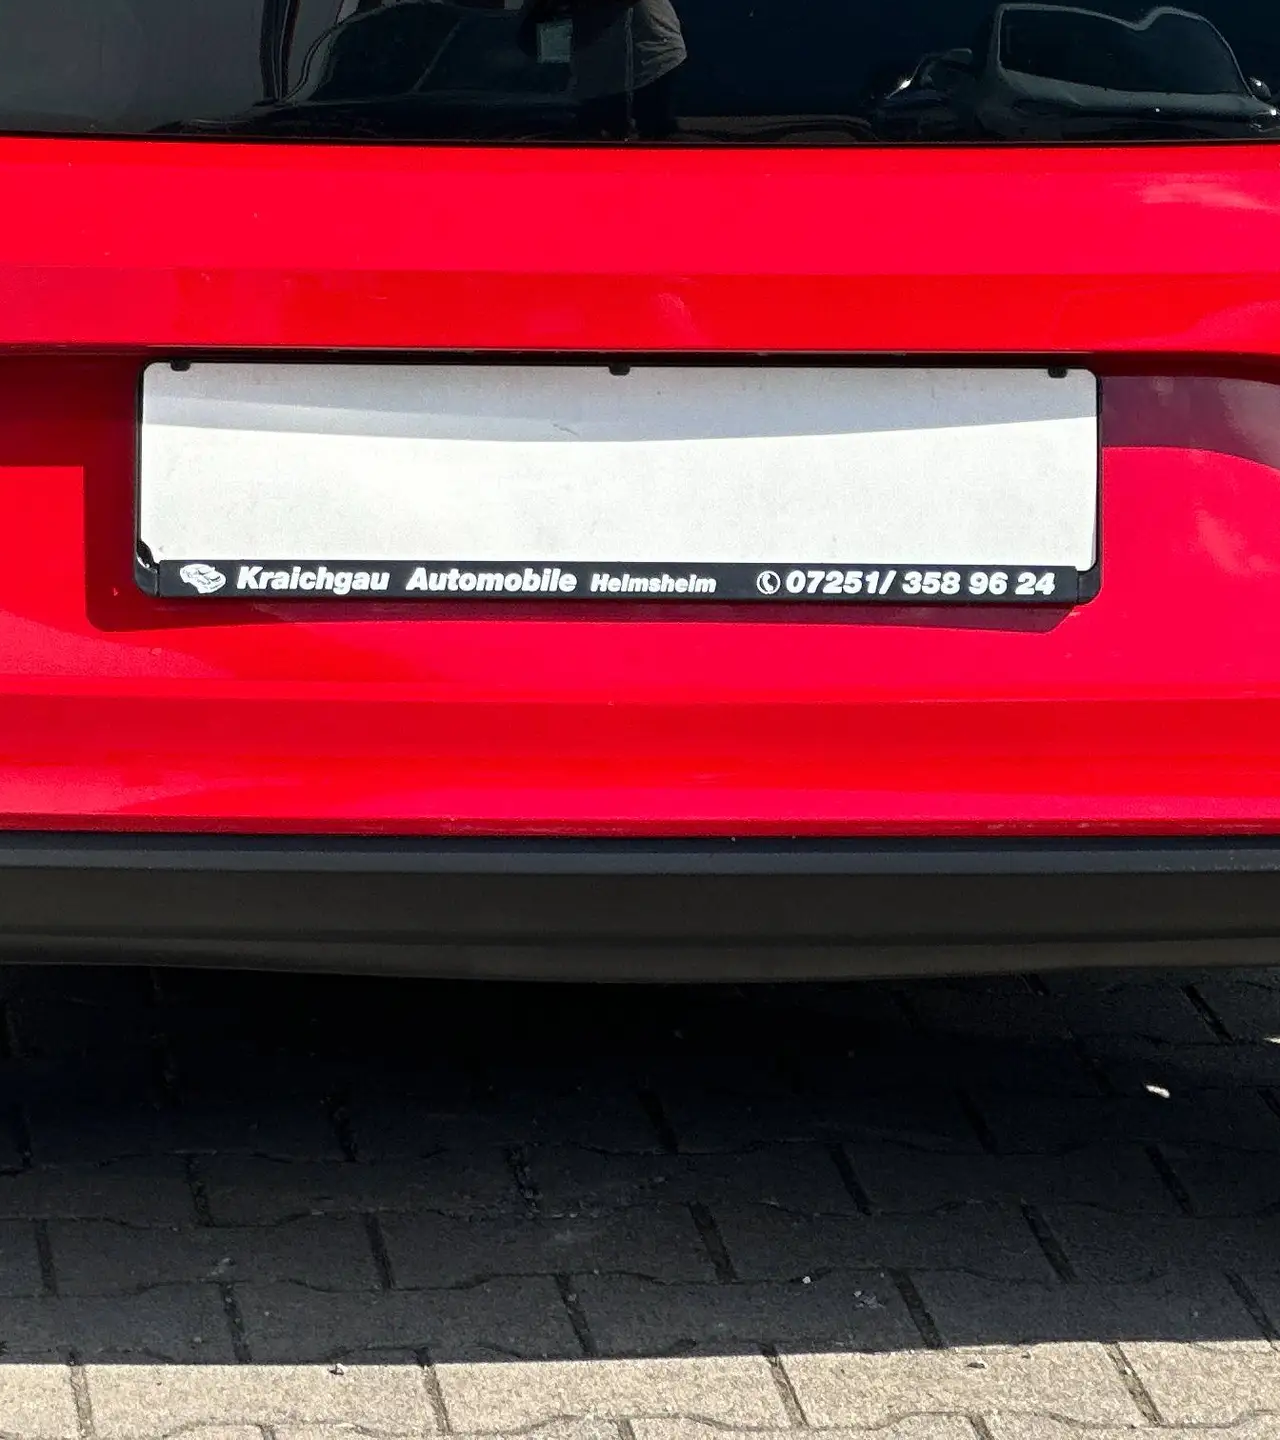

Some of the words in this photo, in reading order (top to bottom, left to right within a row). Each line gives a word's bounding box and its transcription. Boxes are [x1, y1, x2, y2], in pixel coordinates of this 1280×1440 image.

[236, 566, 390, 592] Kraichgau
[406, 567, 577, 592] Automobile
[590, 573, 717, 593] Helmsheim
[786, 570, 896, 594] 07251/
[902, 571, 961, 594] 358
[968, 571, 1008, 595] 96
[1014, 572, 1056, 595] 24
